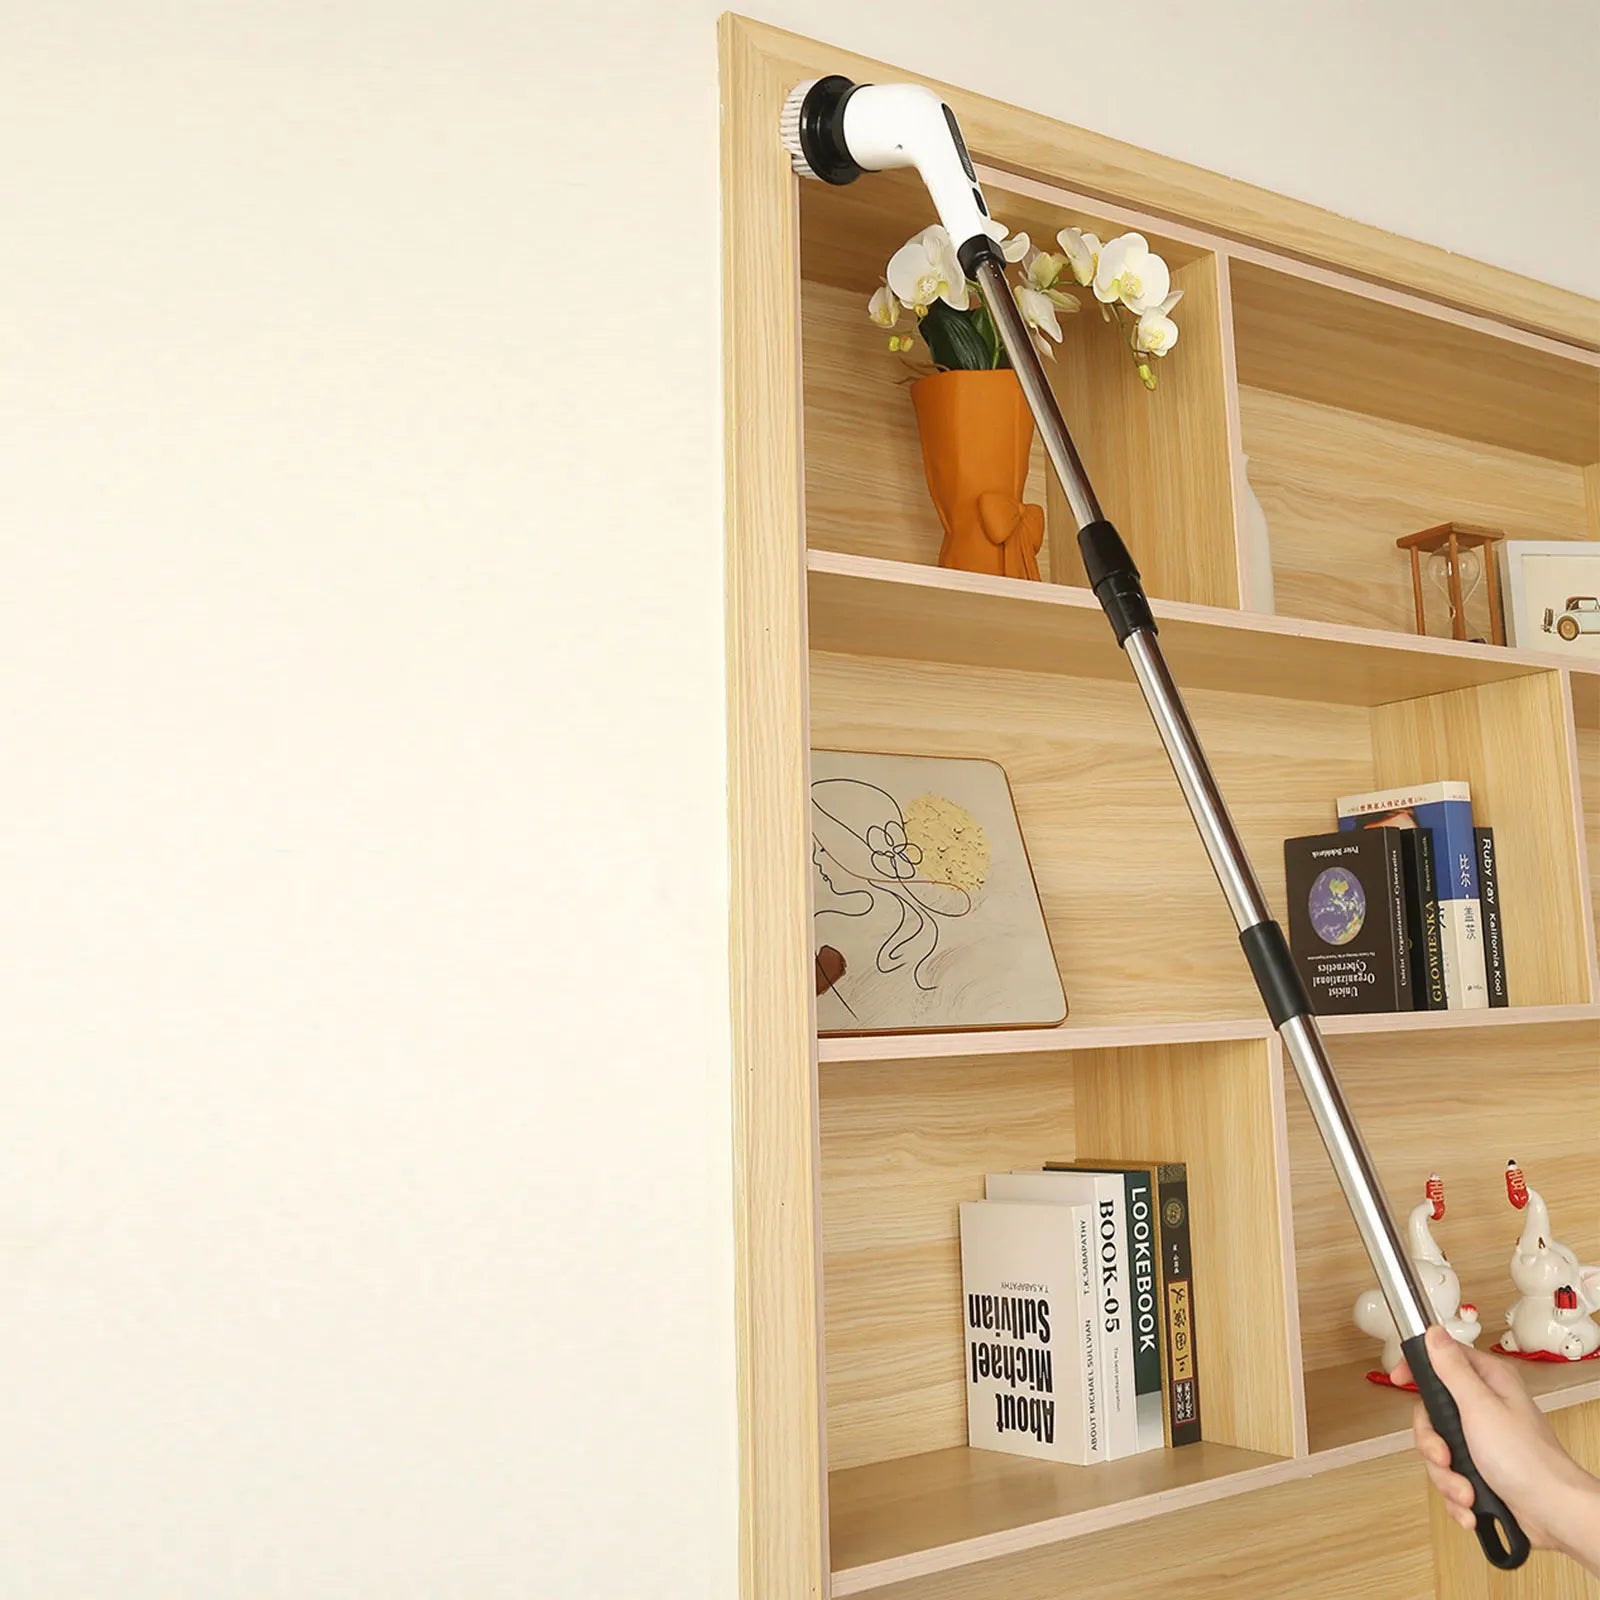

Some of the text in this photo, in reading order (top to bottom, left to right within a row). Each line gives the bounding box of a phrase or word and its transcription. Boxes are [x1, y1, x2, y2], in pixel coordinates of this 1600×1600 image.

[1482, 838, 1495, 905] Ruby ray
[1312, 972, 1375, 987] Organizational
[1318, 960, 1367, 974] Cybernetics
[1489, 912, 1503, 996] Kalifornia Kool
[1328, 986, 1358, 998] Unicist
[1099, 1200, 1120, 1333] BOOK-05
[1131, 1187, 1155, 1353] LOOKEBOOK
[968, 1293, 1051, 1344] Sullvian
[1170, 1287, 1188, 1373] 三国演义
[971, 1341, 1053, 1393] Michael
[1085, 1319, 1098, 1451] ABOUT MICHAEL SULLVIAN
[995, 1393, 1055, 1444] About
